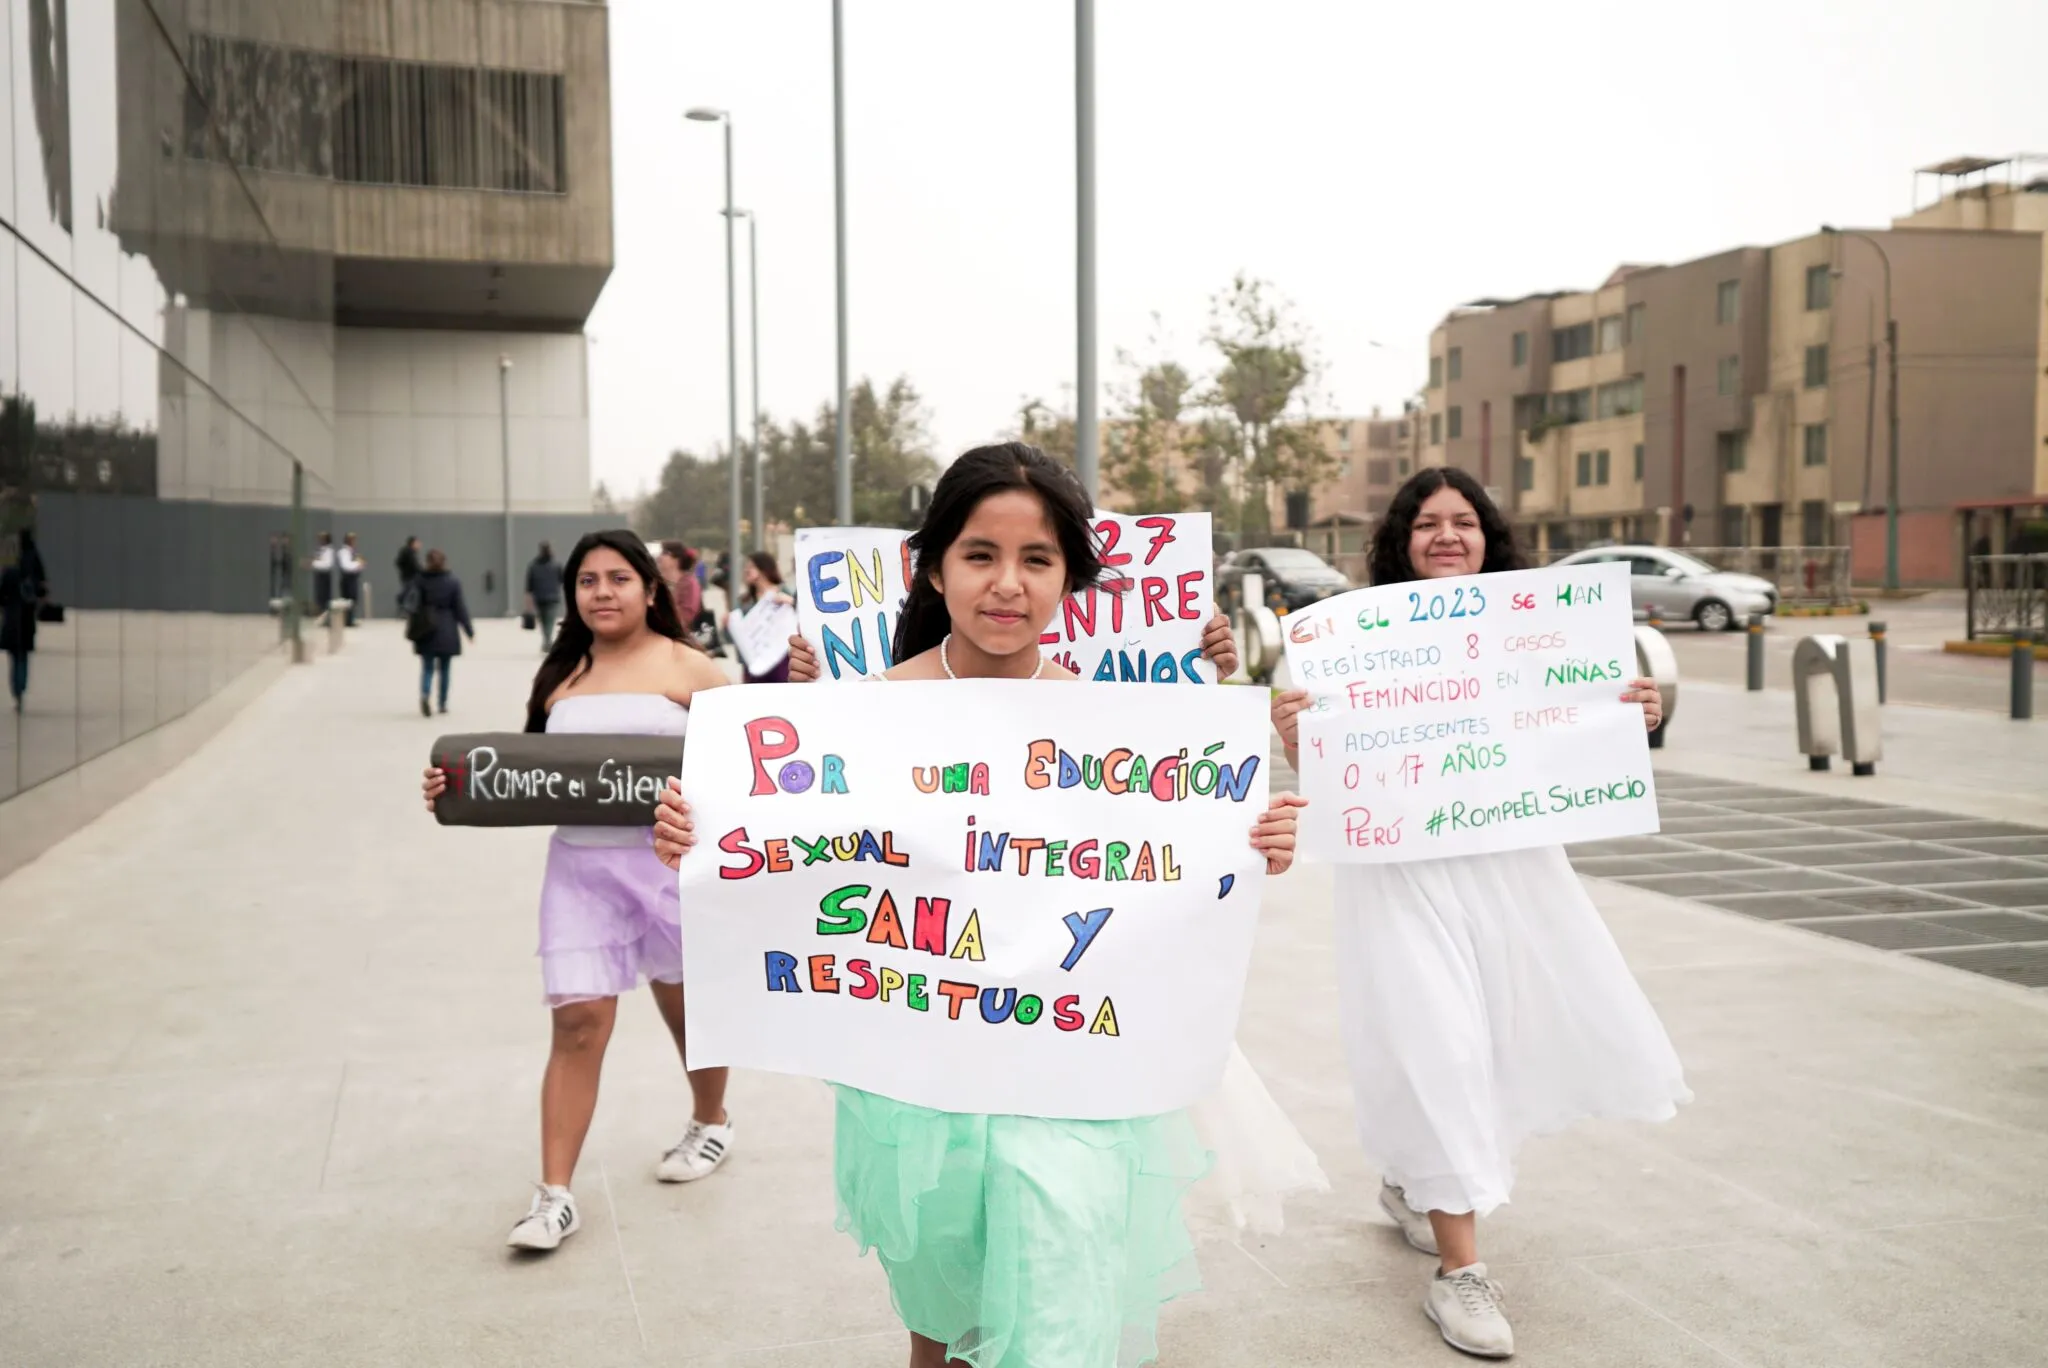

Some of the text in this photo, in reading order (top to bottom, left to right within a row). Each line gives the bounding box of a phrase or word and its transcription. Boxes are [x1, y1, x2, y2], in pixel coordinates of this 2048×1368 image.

[807, 547, 884, 613] EN
[1094, 516, 1177, 567] 27
[1038, 570, 1205, 645] NTRE
[1289, 582, 1603, 644] EN EL 2023 SE HAN
[1301, 630, 1567, 680] REGISTRADO 8 CASOS
[1345, 670, 1481, 710] FEMINICIDIO
[1497, 668, 1520, 690] EN
[1545, 656, 1623, 687] NIÑAS
[1345, 716, 1491, 753] ADOLESCENTES
[1513, 706, 1580, 731] ENTRE
[743, 715, 1261, 803] POR UNA EDUCACIÓN
[1344, 762, 1360, 790] 0
[1396, 754, 1424, 788] 17
[1441, 741, 1507, 776] AÑOS
[718, 826, 910, 880] SEXUAL
[1341, 805, 1405, 848] PERÚ
[816, 884, 1114, 972] SANA Y
[763, 950, 1121, 1037] RESPETUOSA
